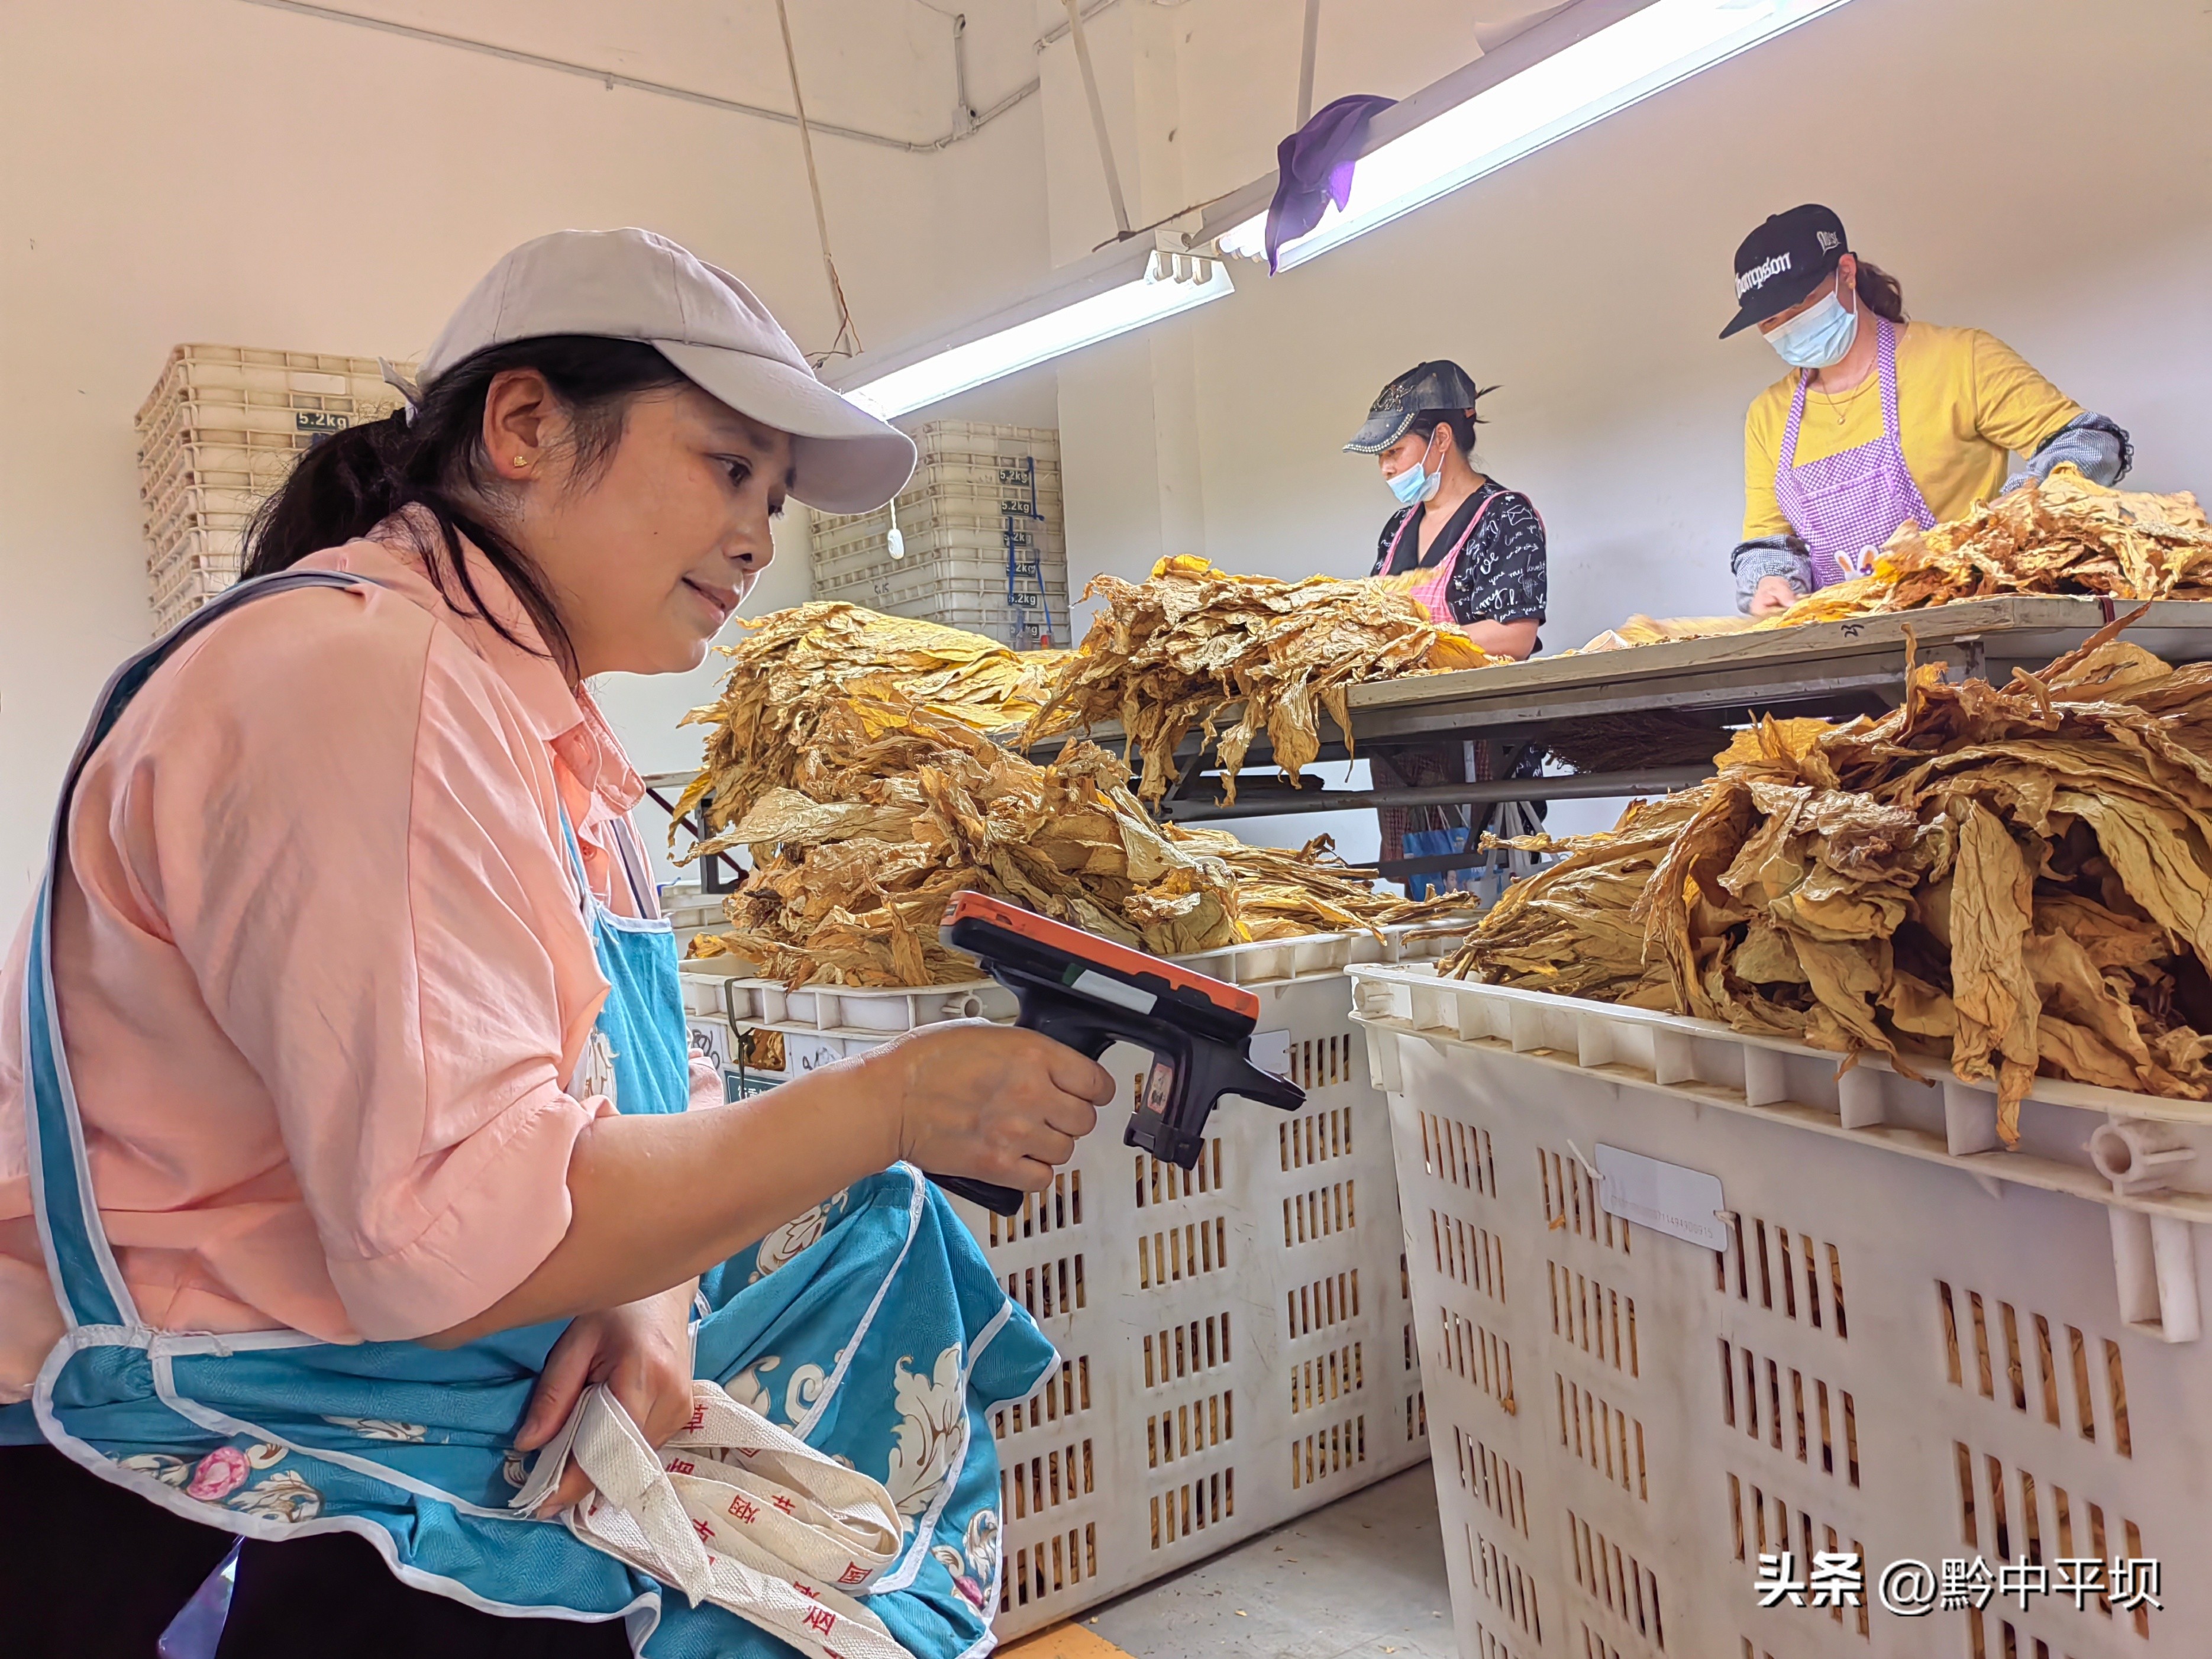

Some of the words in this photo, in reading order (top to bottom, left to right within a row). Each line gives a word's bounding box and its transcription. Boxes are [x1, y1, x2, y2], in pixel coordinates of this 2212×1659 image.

[1735, 251, 1791, 299] hompson
[299, 412, 347, 431] 5.2kg
[1000, 470, 1028, 483] 5.2kg
[1002, 501, 1029, 514] 5.2kg
[1003, 532, 1032, 544] 52kg
